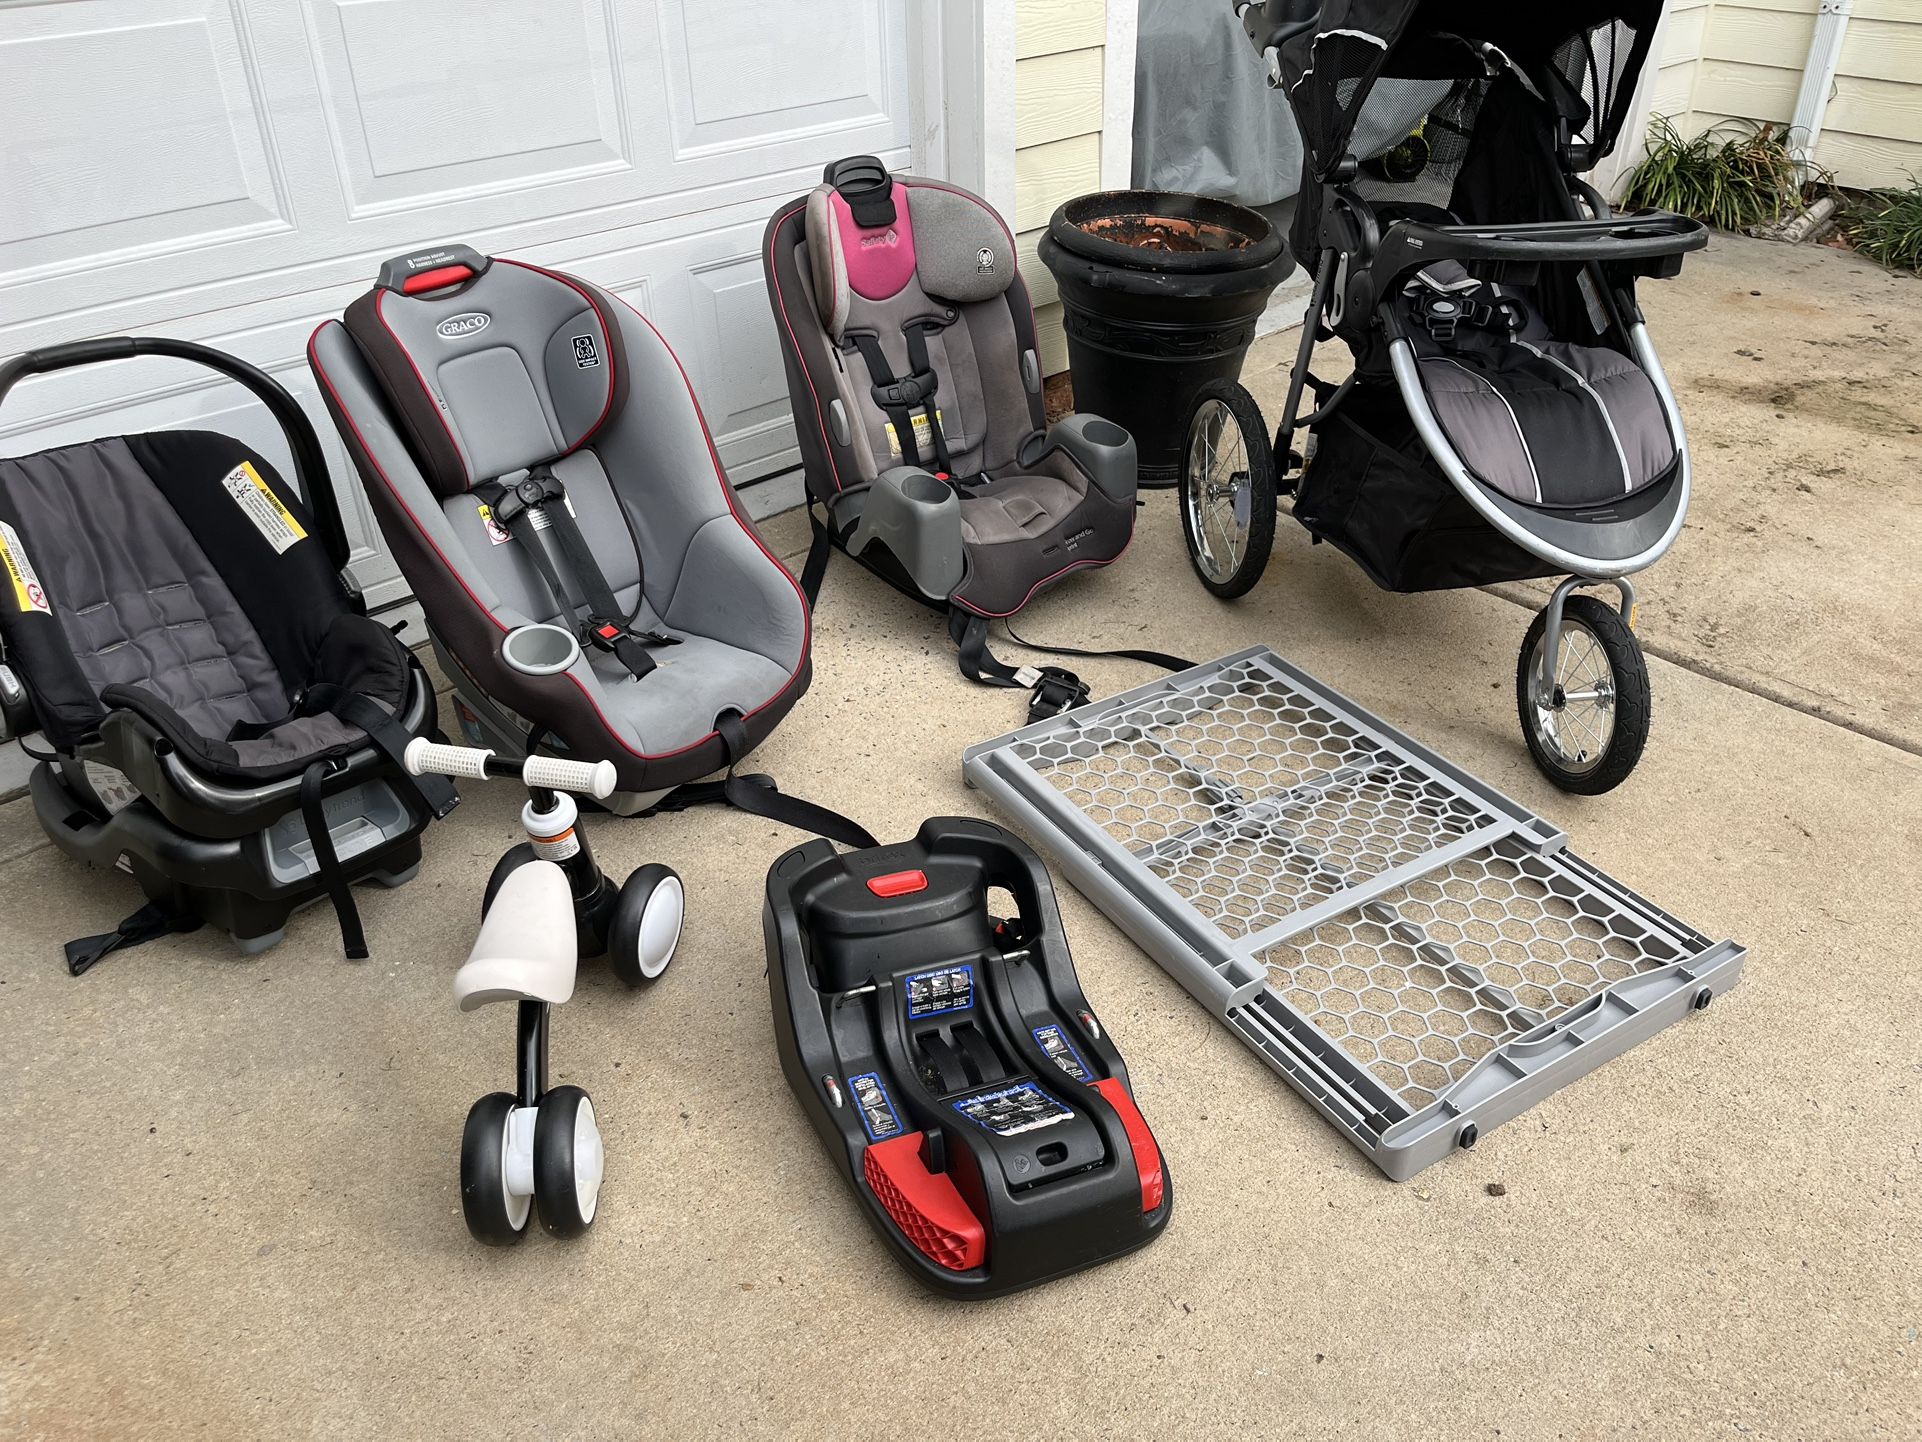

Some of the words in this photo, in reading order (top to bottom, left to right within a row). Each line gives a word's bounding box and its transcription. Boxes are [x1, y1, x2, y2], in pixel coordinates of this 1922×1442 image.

[407, 259, 416, 269] 8
[442, 316, 485, 335] GRACO
[264, 491, 285, 516] WARNING
[2, 547, 20, 577] WARNING
